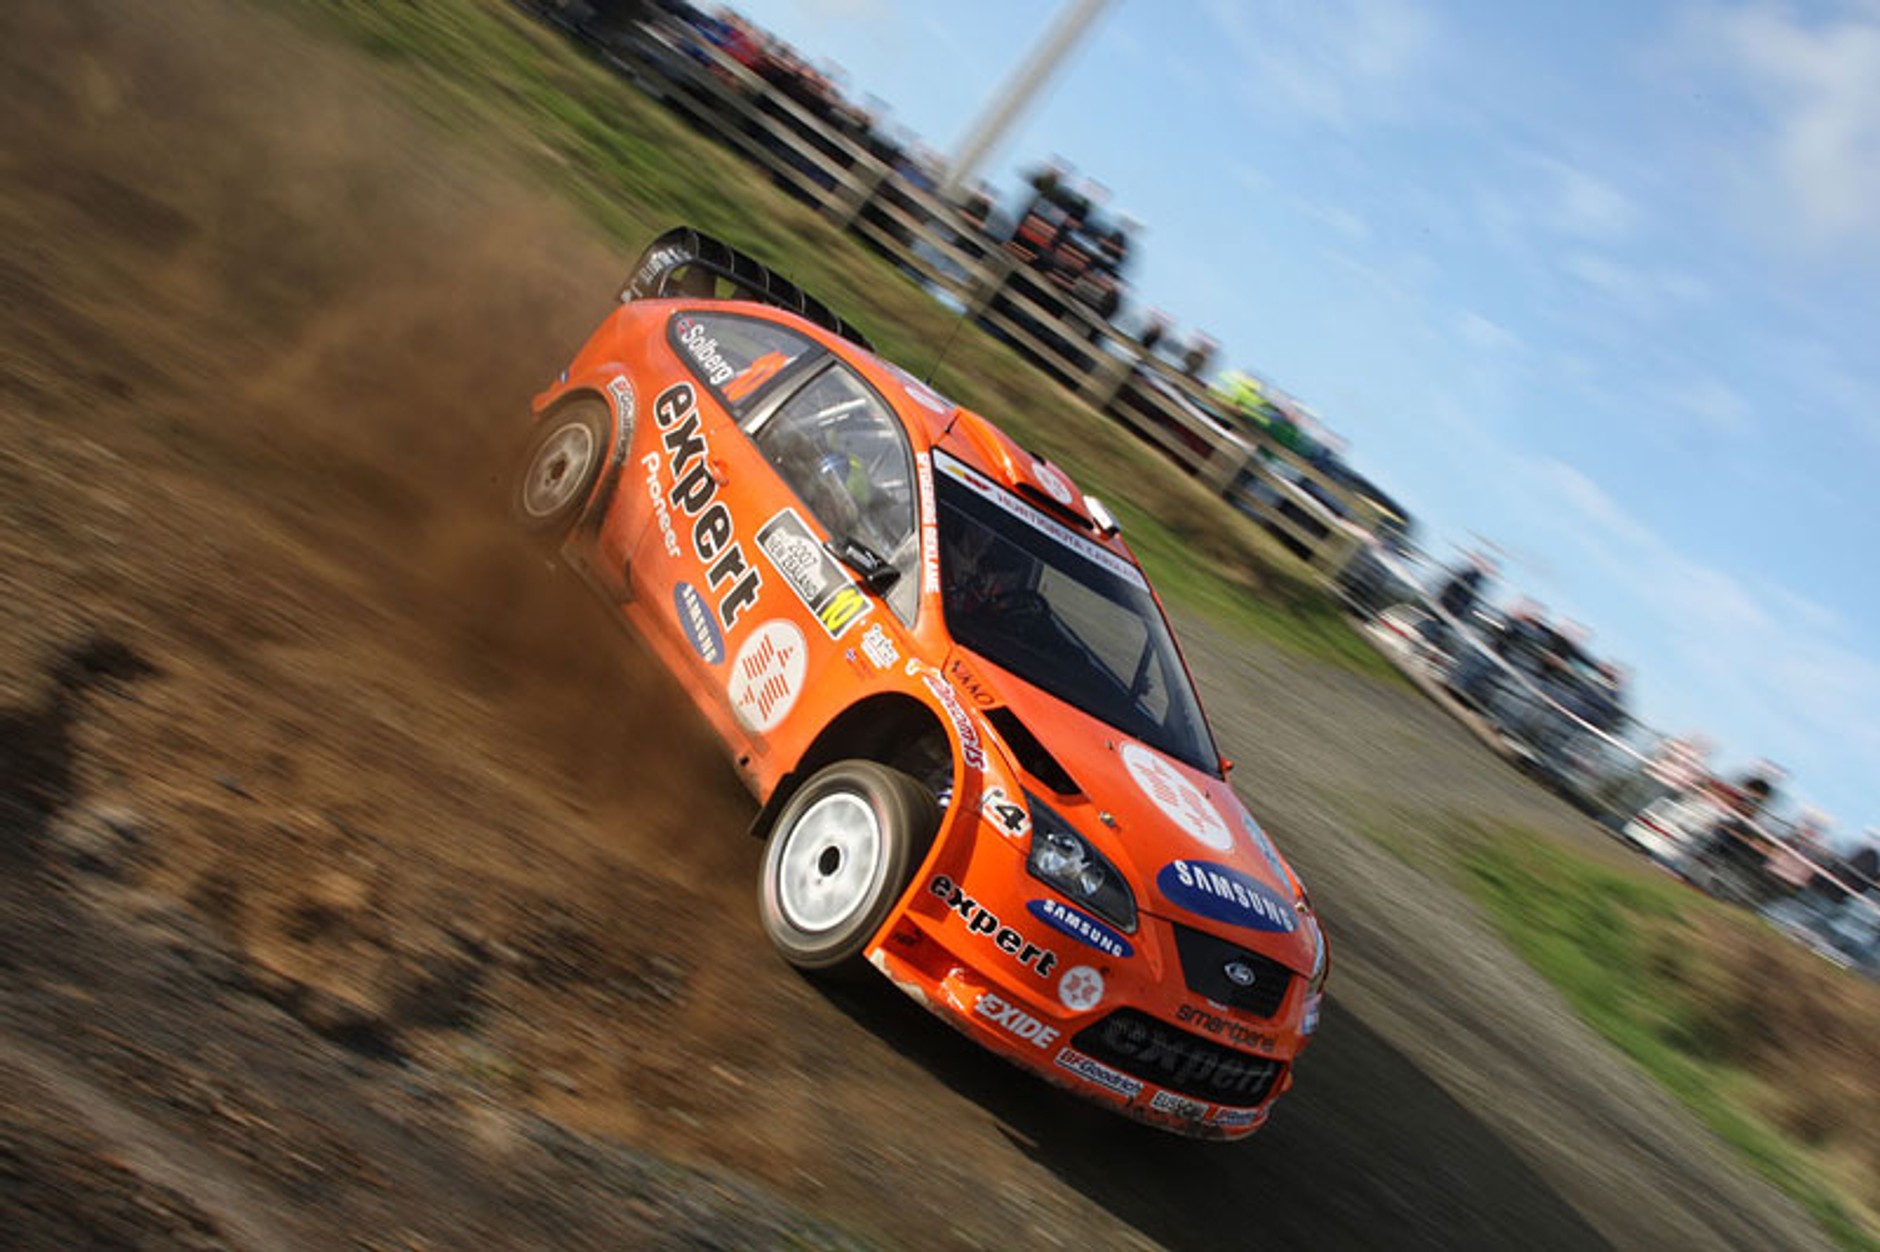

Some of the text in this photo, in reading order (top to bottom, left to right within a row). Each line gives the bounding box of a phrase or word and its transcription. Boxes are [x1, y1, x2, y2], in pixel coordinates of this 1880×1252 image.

[681, 324, 734, 385] Solberg
[641, 451, 682, 557] Pioneer
[655, 382, 761, 630] expert
[682, 582, 719, 662] SAMSUNG
[820, 587, 864, 631] 10
[930, 876, 1057, 977] expert
[1043, 899, 1124, 957] SAMSUNG
[1174, 859, 1295, 932] SAMSUNG
[975, 992, 1062, 1049] EXIDE
